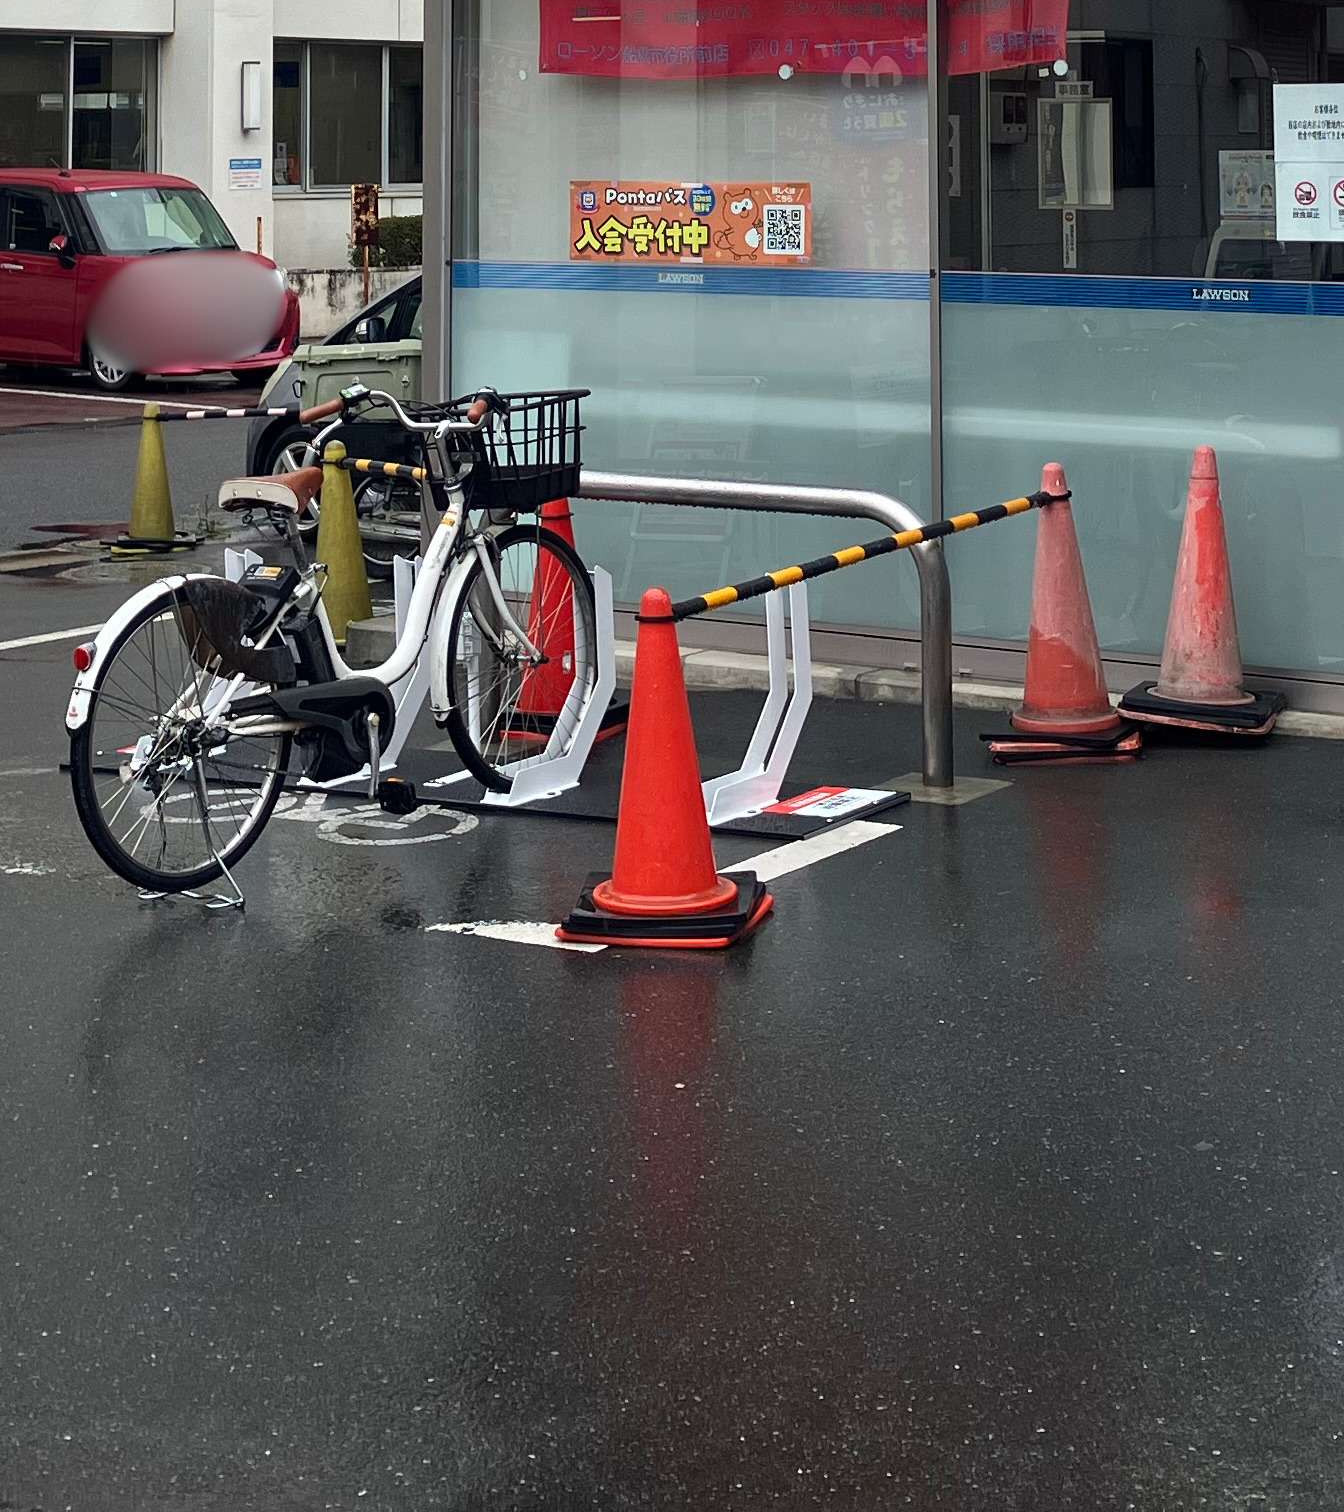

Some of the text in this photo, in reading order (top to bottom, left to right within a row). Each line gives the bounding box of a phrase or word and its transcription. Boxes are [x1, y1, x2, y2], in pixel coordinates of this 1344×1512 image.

[605, 187, 687, 206] Pontaパス
[574, 214, 710, 255] 入会受付中
[658, 273, 705, 285] LAWSON
[1192, 288, 1249, 302] LAWSON
